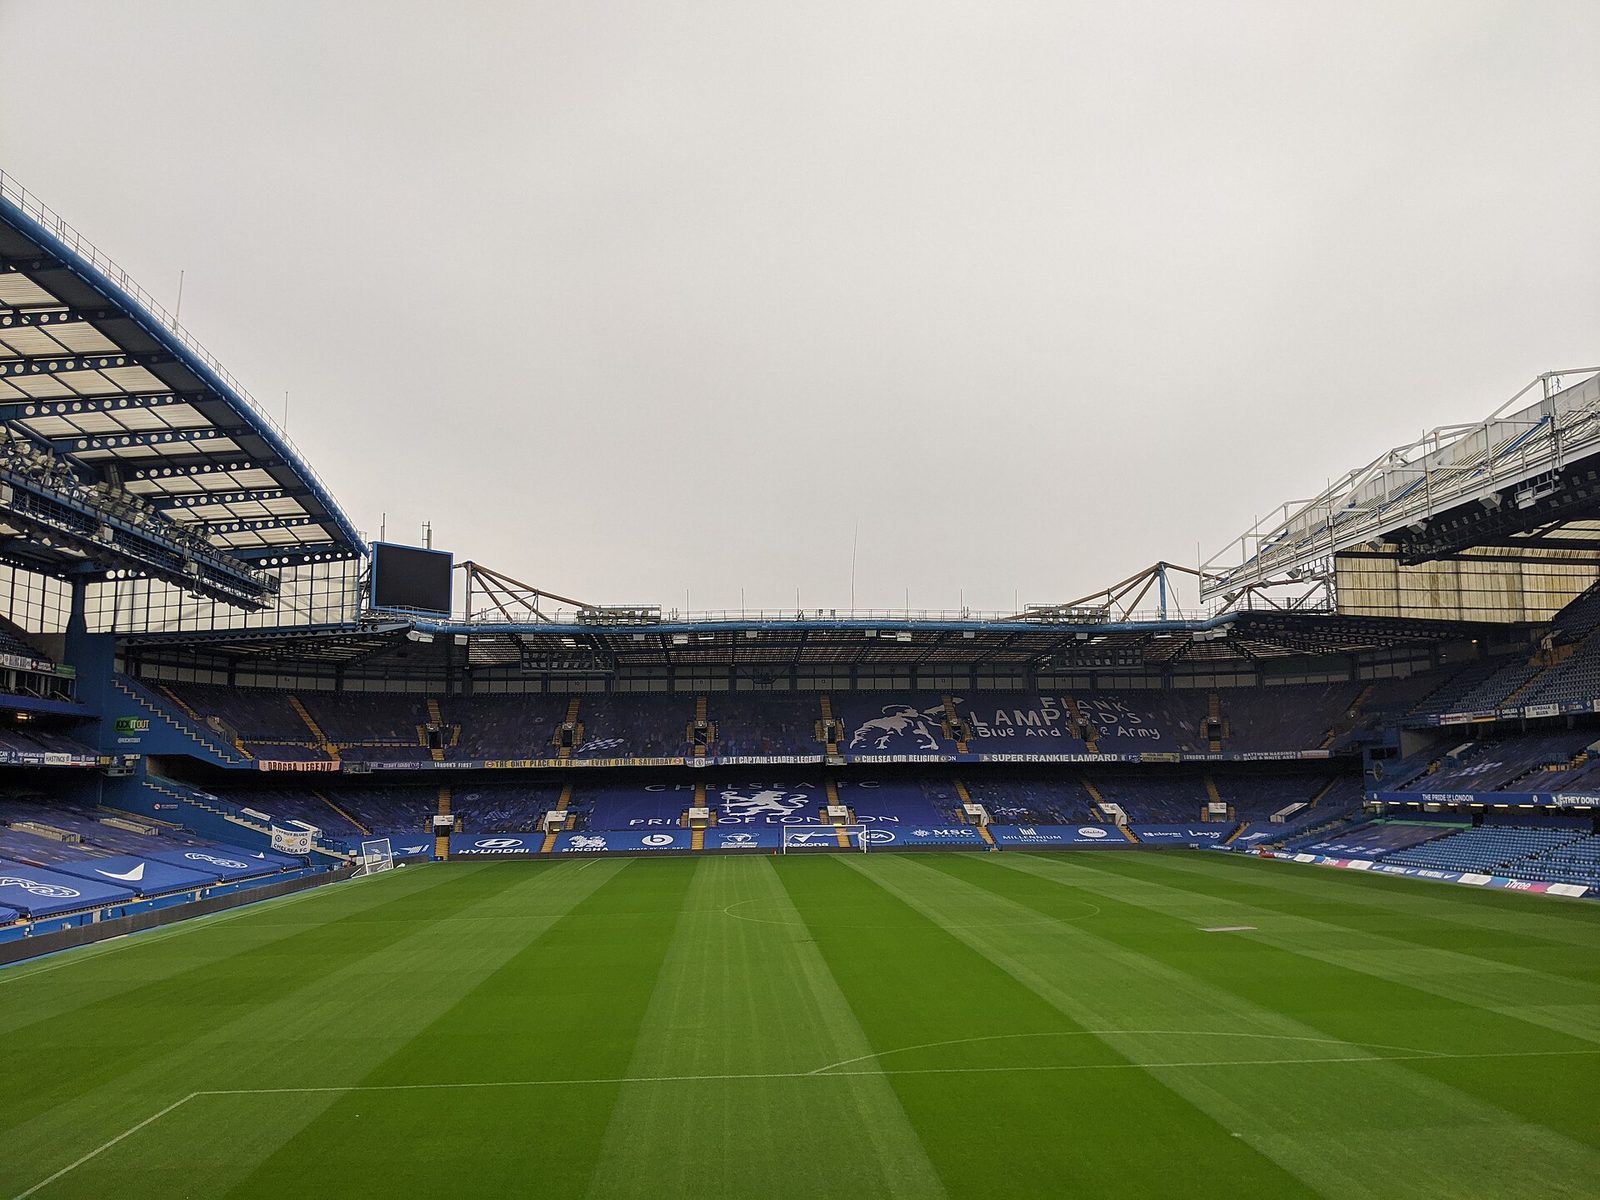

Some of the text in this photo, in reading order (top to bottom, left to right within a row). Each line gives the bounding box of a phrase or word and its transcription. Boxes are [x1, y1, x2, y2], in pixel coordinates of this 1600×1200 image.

[136, 719, 150, 729] OUT
[977, 726, 1015, 738] Blue
[1025, 727, 1061, 738] And
[1117, 725, 1161, 740] Army
[530, 760, 551, 768] PLACE
[638, 758, 672, 766] SATURDAY
[862, 755, 939, 763] CHELSEA OUR RELIGION
[991, 754, 1118, 762] SUPER FRANKIE LAMPARD
[267, 761, 333, 772] DROGBA LEGEND
[1452, 794, 1474, 802] LONDON
[1563, 796, 1581, 804] THEY
[273, 843, 299, 853] CHELSEA
[1504, 878, 1532, 890] Three
